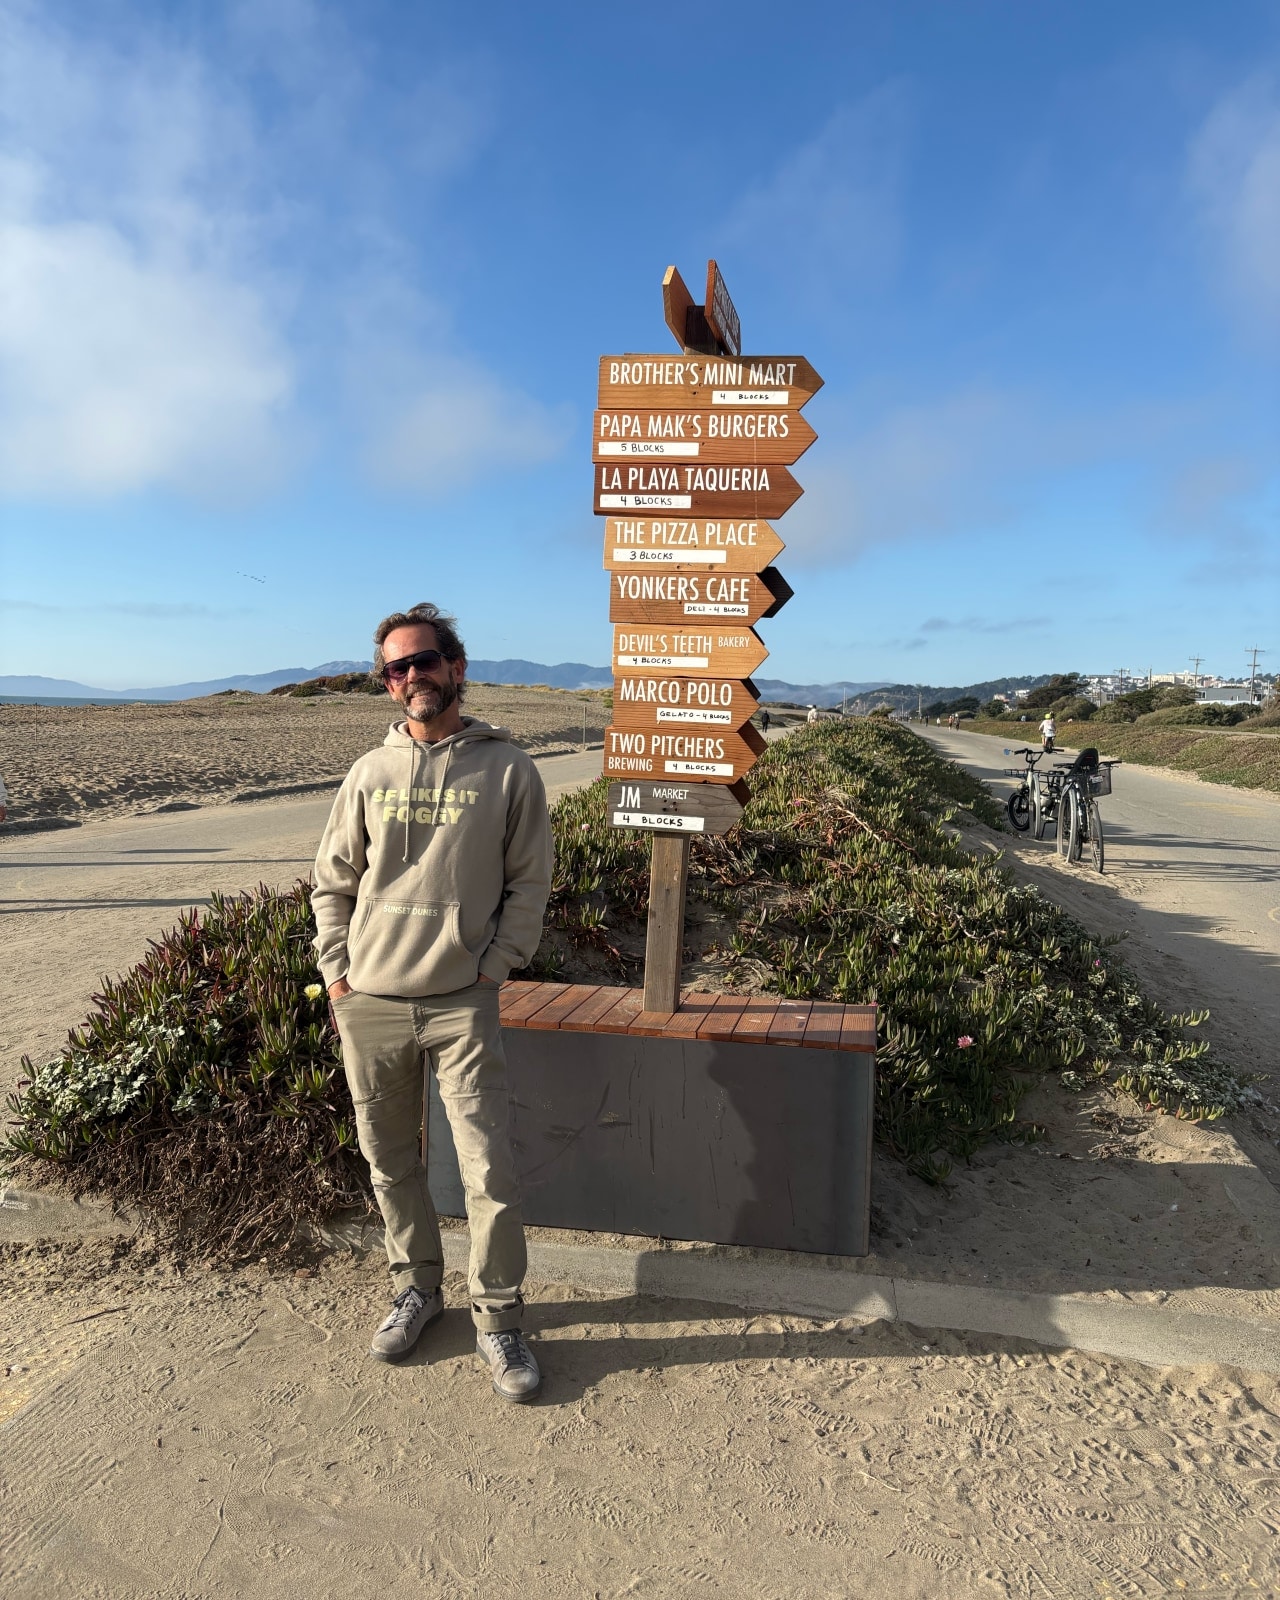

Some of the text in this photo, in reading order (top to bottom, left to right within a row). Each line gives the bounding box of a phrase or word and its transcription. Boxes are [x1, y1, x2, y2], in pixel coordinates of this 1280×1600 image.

[610, 362, 797, 386] BROTHER'S MINI MART
[600, 414, 789, 438] PAPA MAK'S BURGERS
[620, 443, 665, 453] 5 BLOCKS
[601, 467, 770, 491] LA PLAYA TAQUERIA
[620, 496, 673, 506] 4 BLOCKS
[614, 521, 758, 546] THE PIZZA PLACE
[629, 551, 674, 560] 3 BLOCKS
[617, 575, 750, 602] YONKERS CAFE
[619, 634, 750, 654] DEVIL'S TEETH BAKERY
[632, 657, 672, 665] 4 BLOCKS
[620, 678, 733, 706] MARCO POLO
[659, 710, 694, 718] GELATO
[702, 712, 707, 720] 4
[610, 732, 725, 759] TWO PITCHERS
[608, 756, 653, 772] BREWING
[672, 763, 716, 772] 4 BLOCKS
[372, 787, 479, 805] SF LIKES IT
[617, 785, 690, 809] JM MARKET
[622, 814, 683, 827] 4 BLOCKS
[383, 904, 438, 917] SUNSET DUNES
